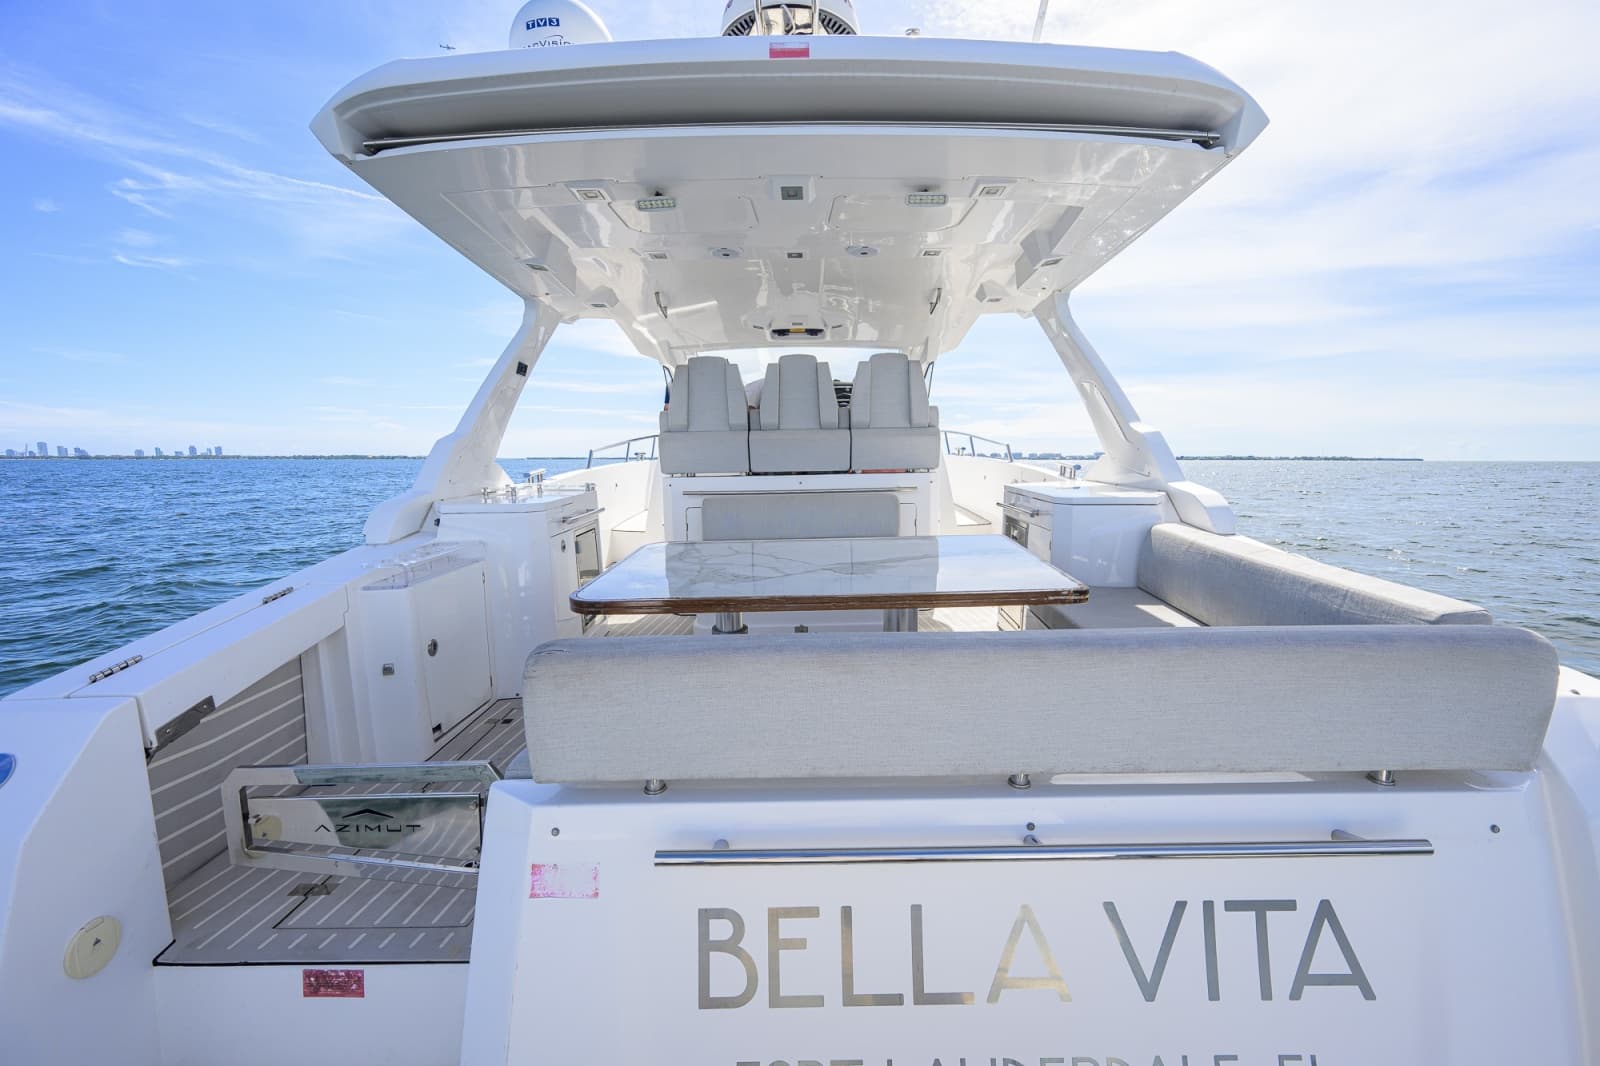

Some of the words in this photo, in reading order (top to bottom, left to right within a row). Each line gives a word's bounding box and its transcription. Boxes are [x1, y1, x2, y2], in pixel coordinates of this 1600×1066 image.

[526, 17, 560, 31] TV3
[314, 823, 421, 833] AZIMUT
[698, 903, 1073, 1010] BELLA
[1103, 899, 1377, 1002] VITA
